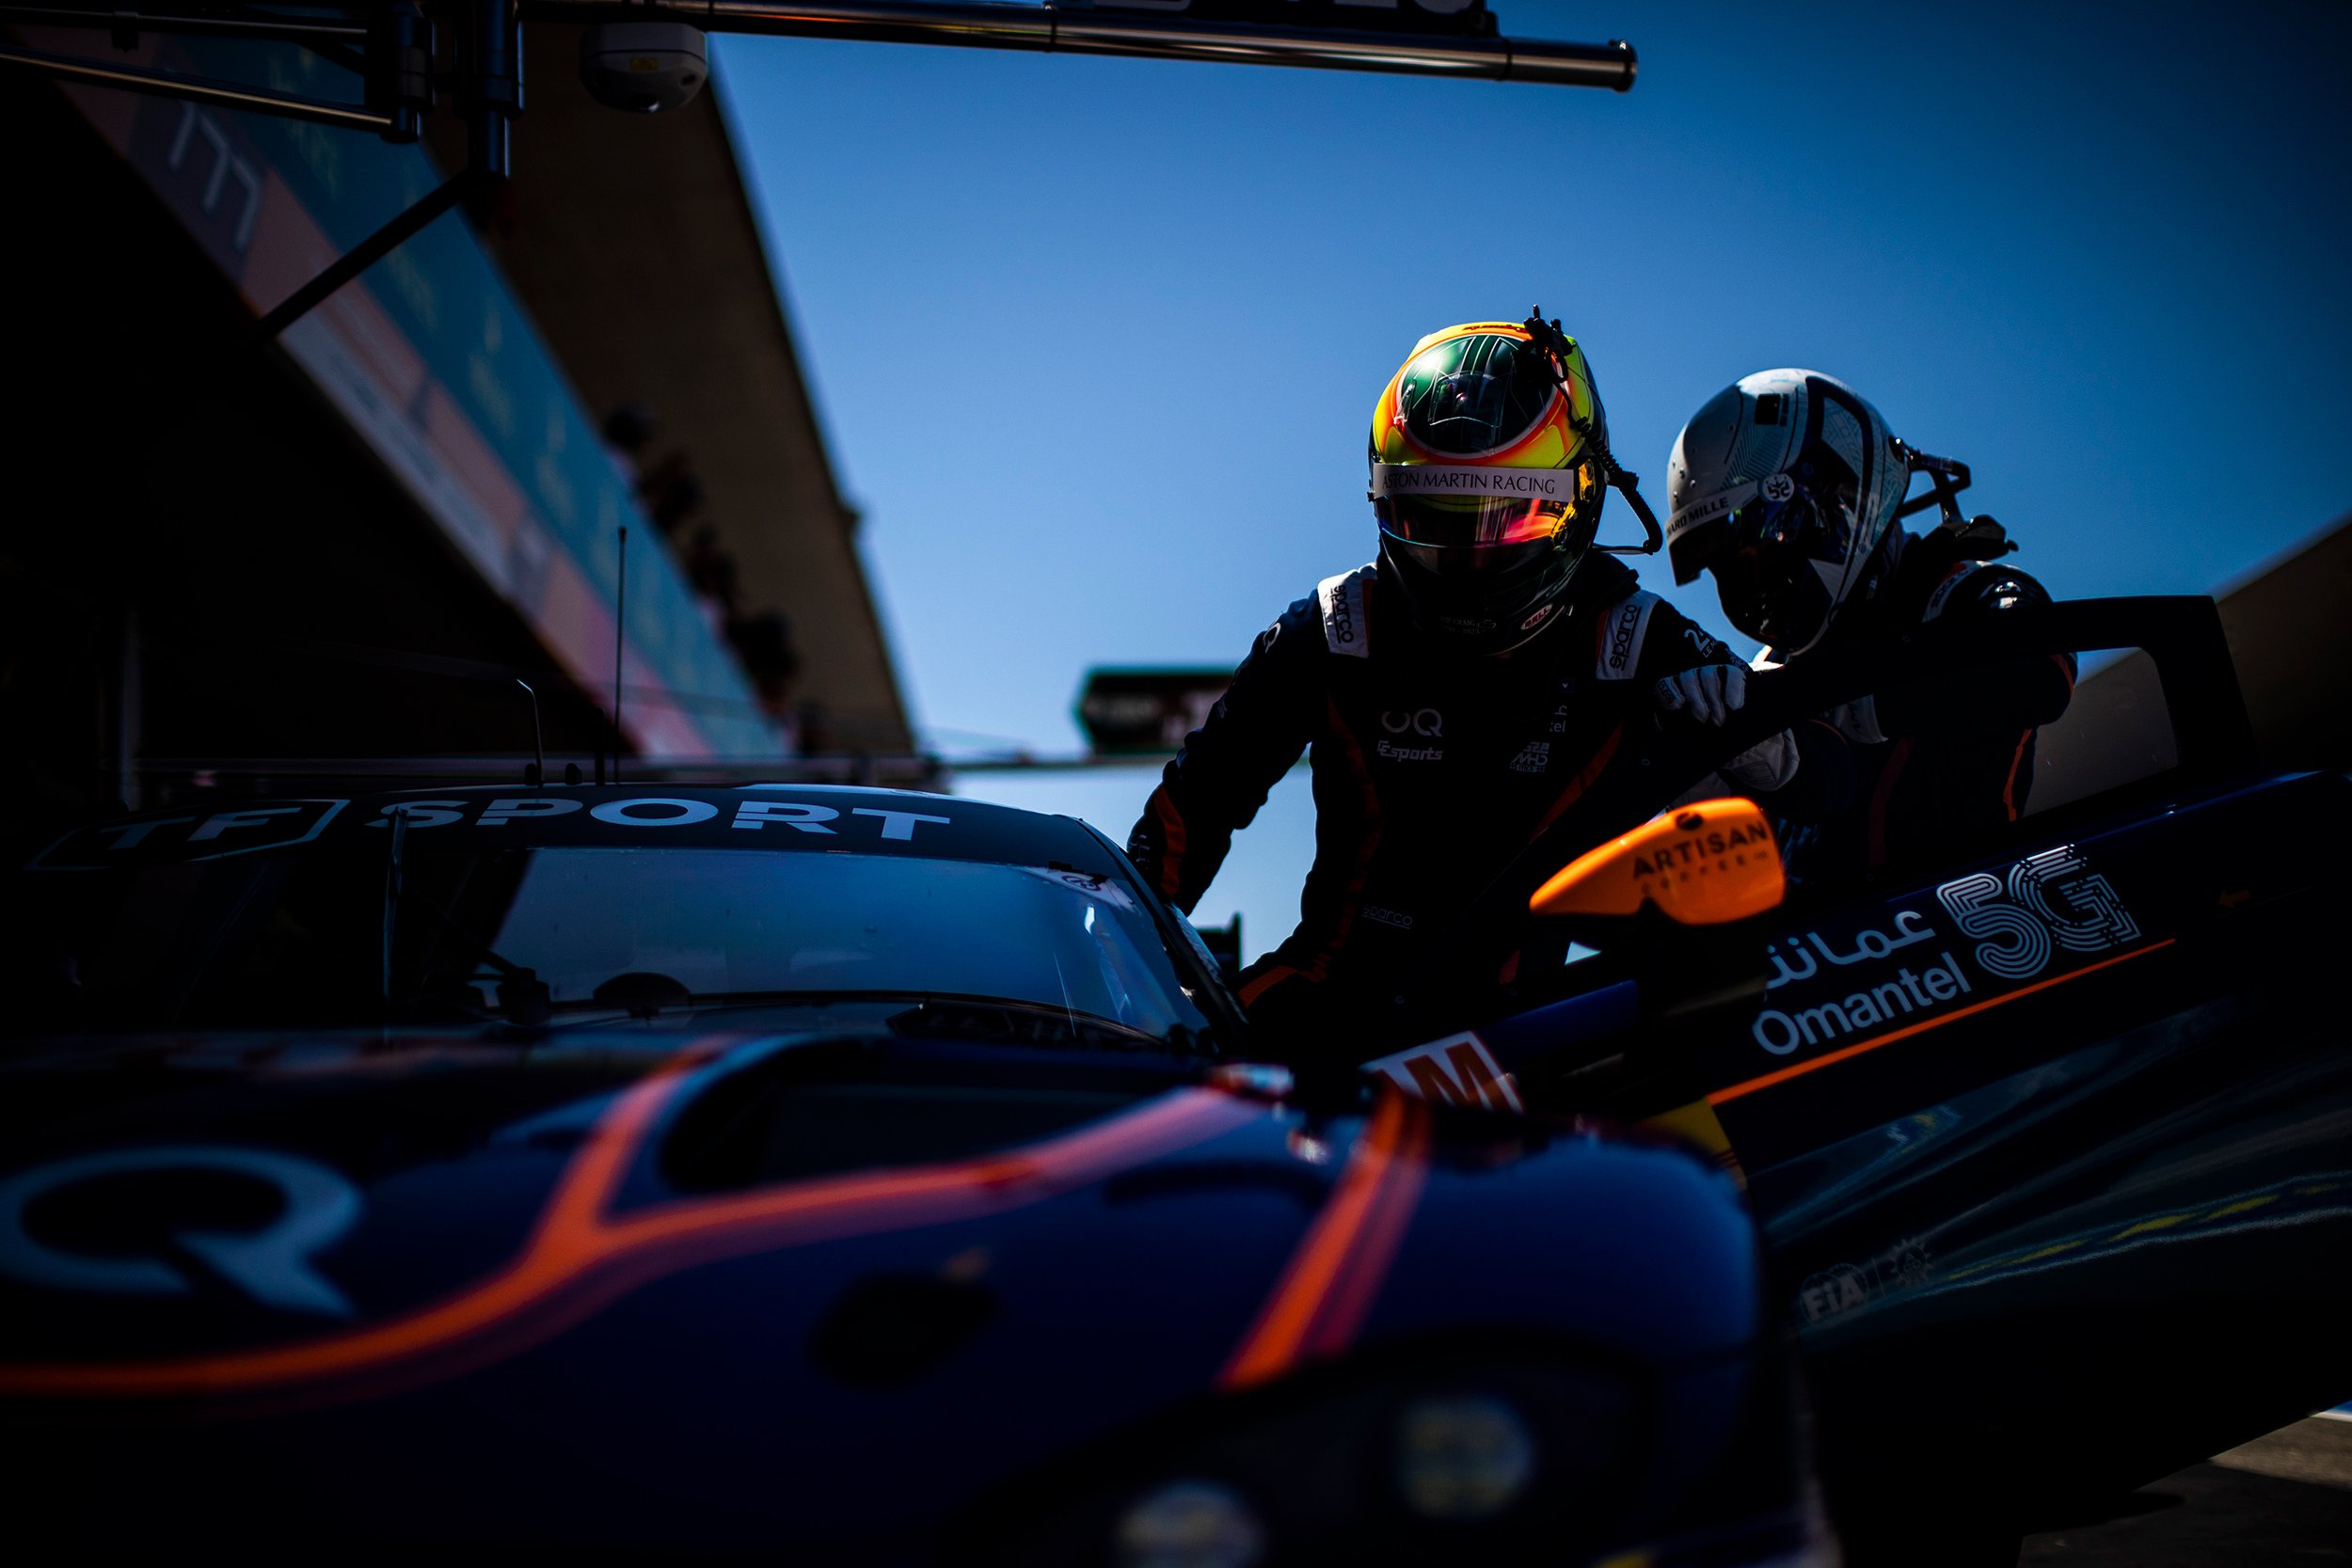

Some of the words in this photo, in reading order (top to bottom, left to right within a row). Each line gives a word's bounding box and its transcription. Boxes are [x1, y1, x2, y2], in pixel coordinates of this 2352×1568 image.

[1383, 473, 1420, 488] ASTON
[1422, 472, 1487, 488] MARTIN
[1492, 475, 1555, 494] RACING
[1688, 497, 1729, 523] MILLE
[1330, 585, 1354, 643] sparco
[1610, 604, 1641, 670] sparco
[100, 804, 301, 850] TF
[365, 798, 950, 840] SPORT
[1633, 823, 1768, 879] ARTISAN
[1362, 903, 1413, 928] sparco
[1936, 845, 2142, 979] 5G
[1751, 952, 1972, 1055] Omantel
